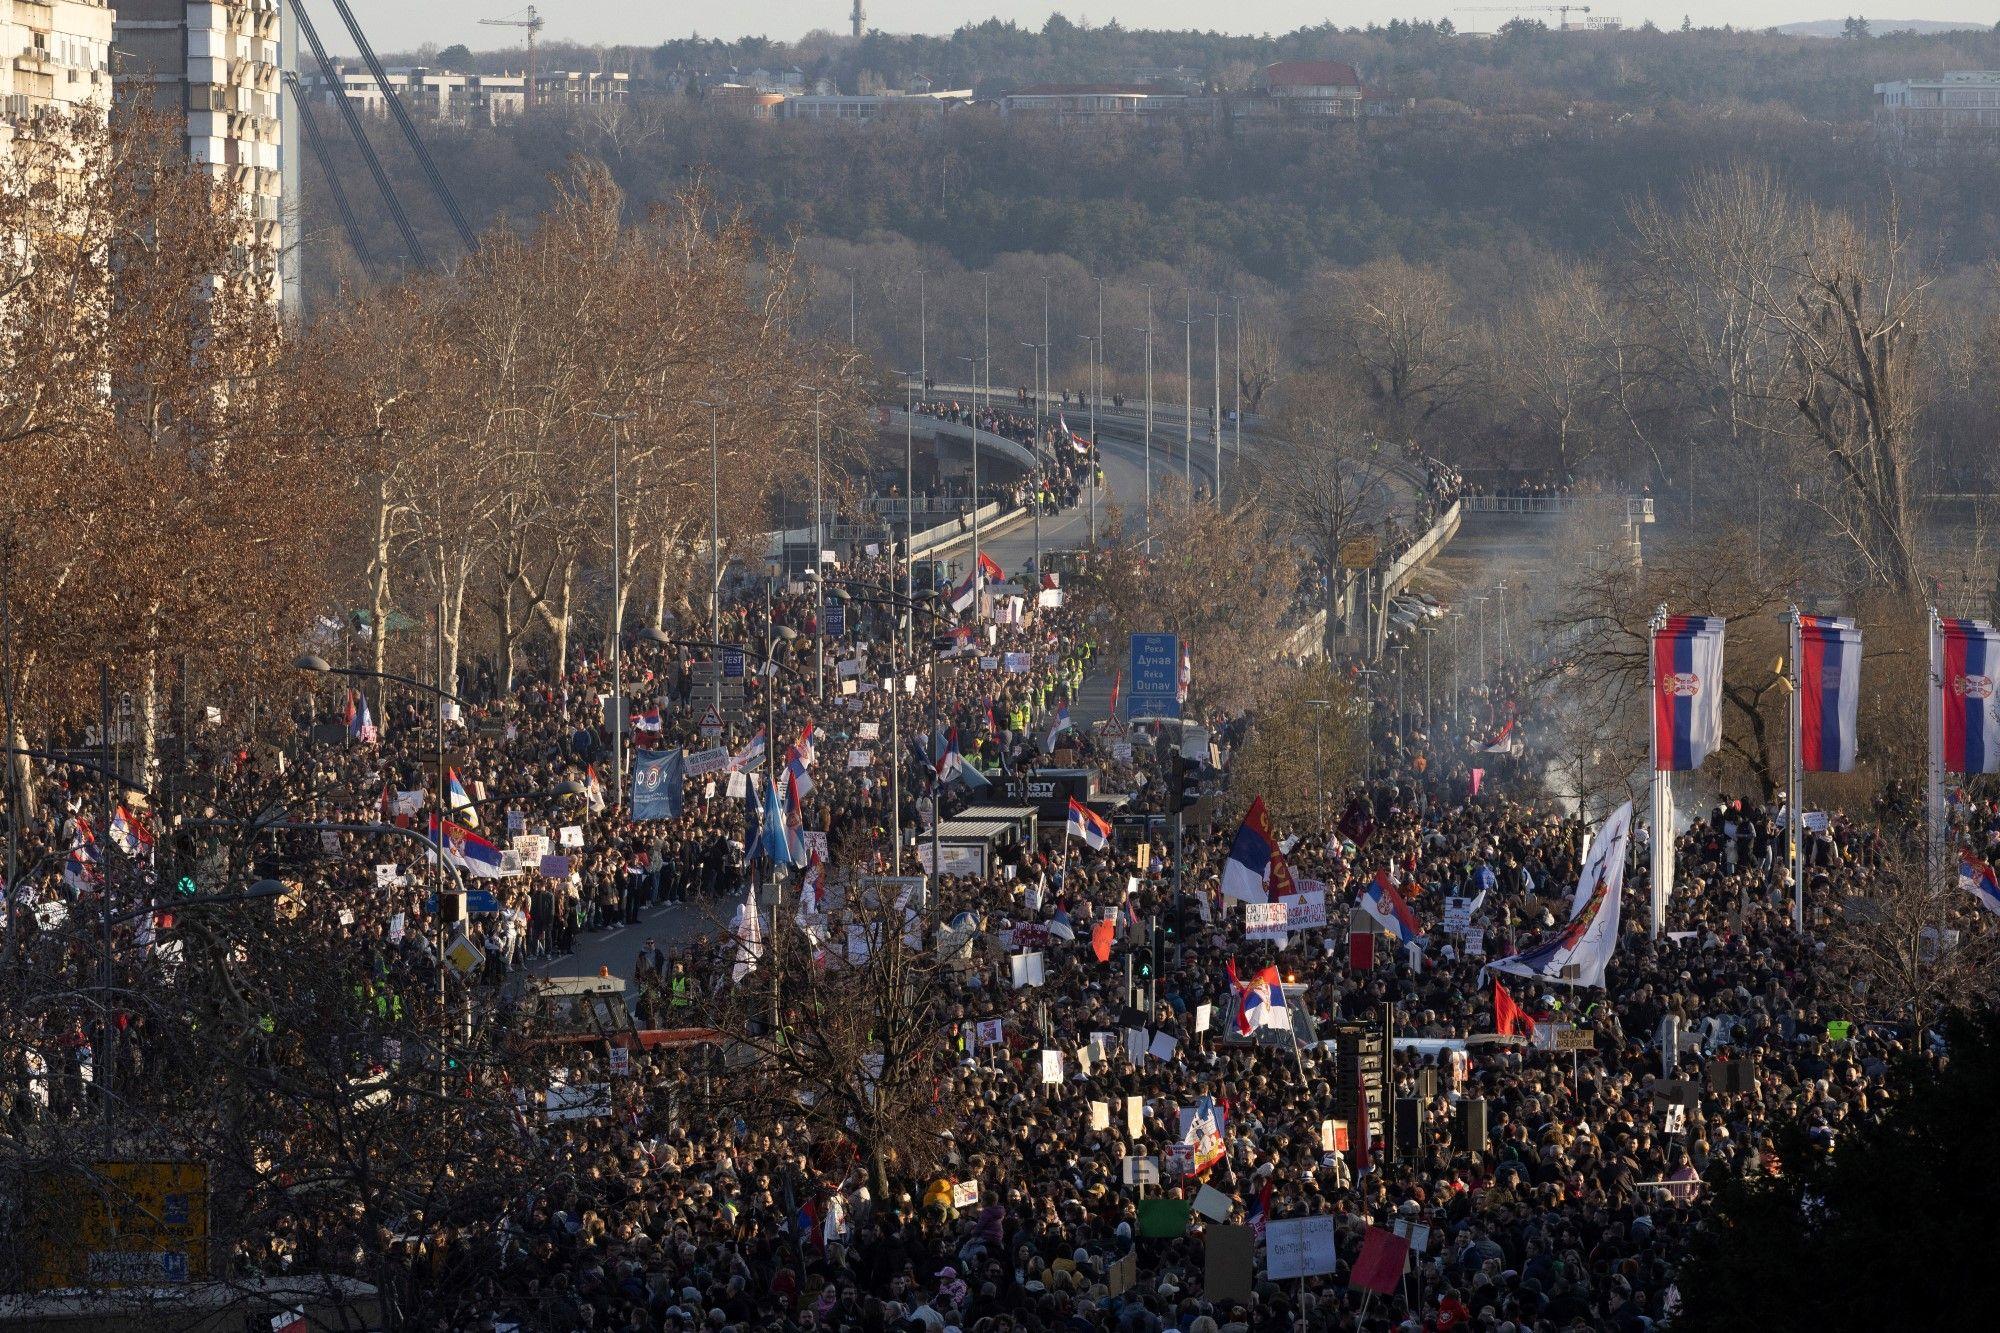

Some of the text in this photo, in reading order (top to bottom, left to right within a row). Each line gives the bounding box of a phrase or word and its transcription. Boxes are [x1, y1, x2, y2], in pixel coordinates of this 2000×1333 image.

[826, 615, 843, 623] TEST
[1144, 644, 1164, 653] Река
[724, 655, 743, 664] TEST
[1137, 654, 1171, 667] Дунав
[1144, 670, 1164, 678] Reka
[1137, 680, 1170, 690] Dunav
